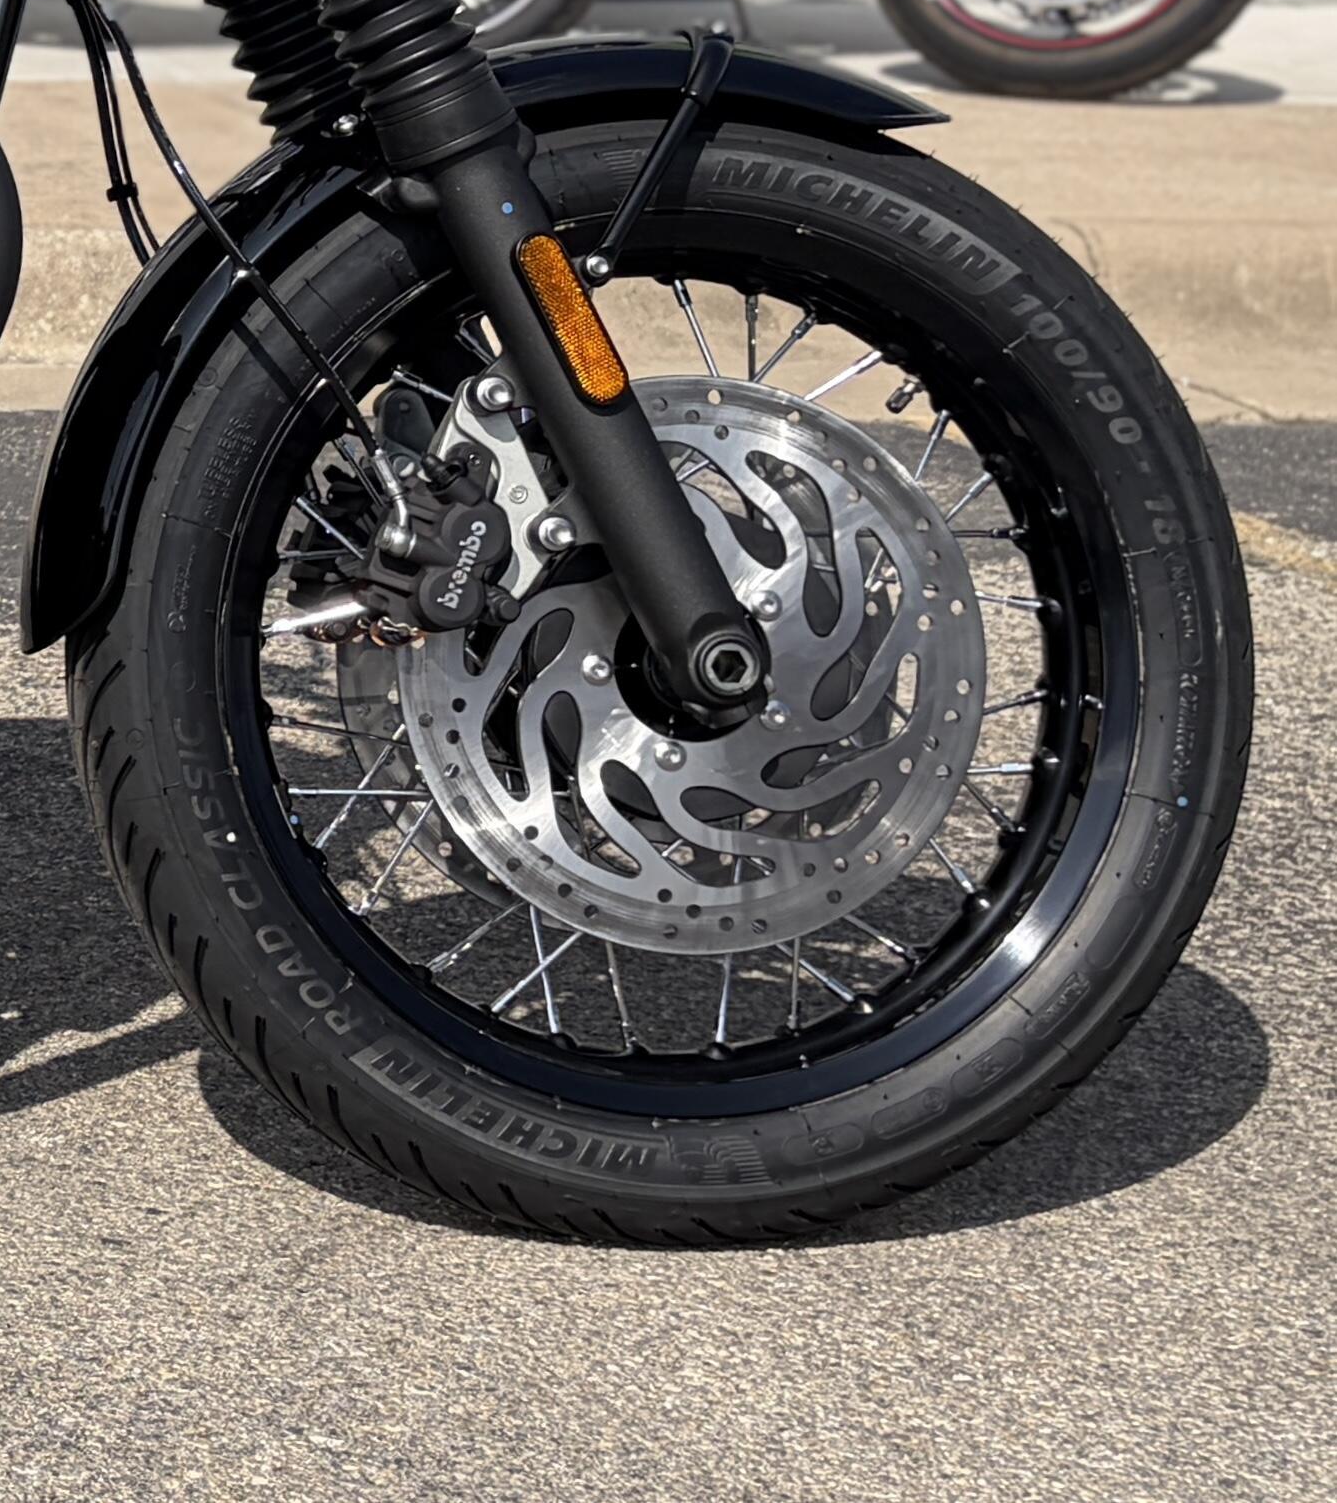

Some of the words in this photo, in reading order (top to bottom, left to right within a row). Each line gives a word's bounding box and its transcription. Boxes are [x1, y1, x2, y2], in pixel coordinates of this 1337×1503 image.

[712, 156, 1002, 281] MICHELIN
[1009, 293, 1143, 445] 100/90
[437, 520, 487, 609] brembo
[173, 715, 265, 911] CLASSIC
[255, 922, 358, 1037] ROAD
[370, 1045, 663, 1177] MICHELIN
